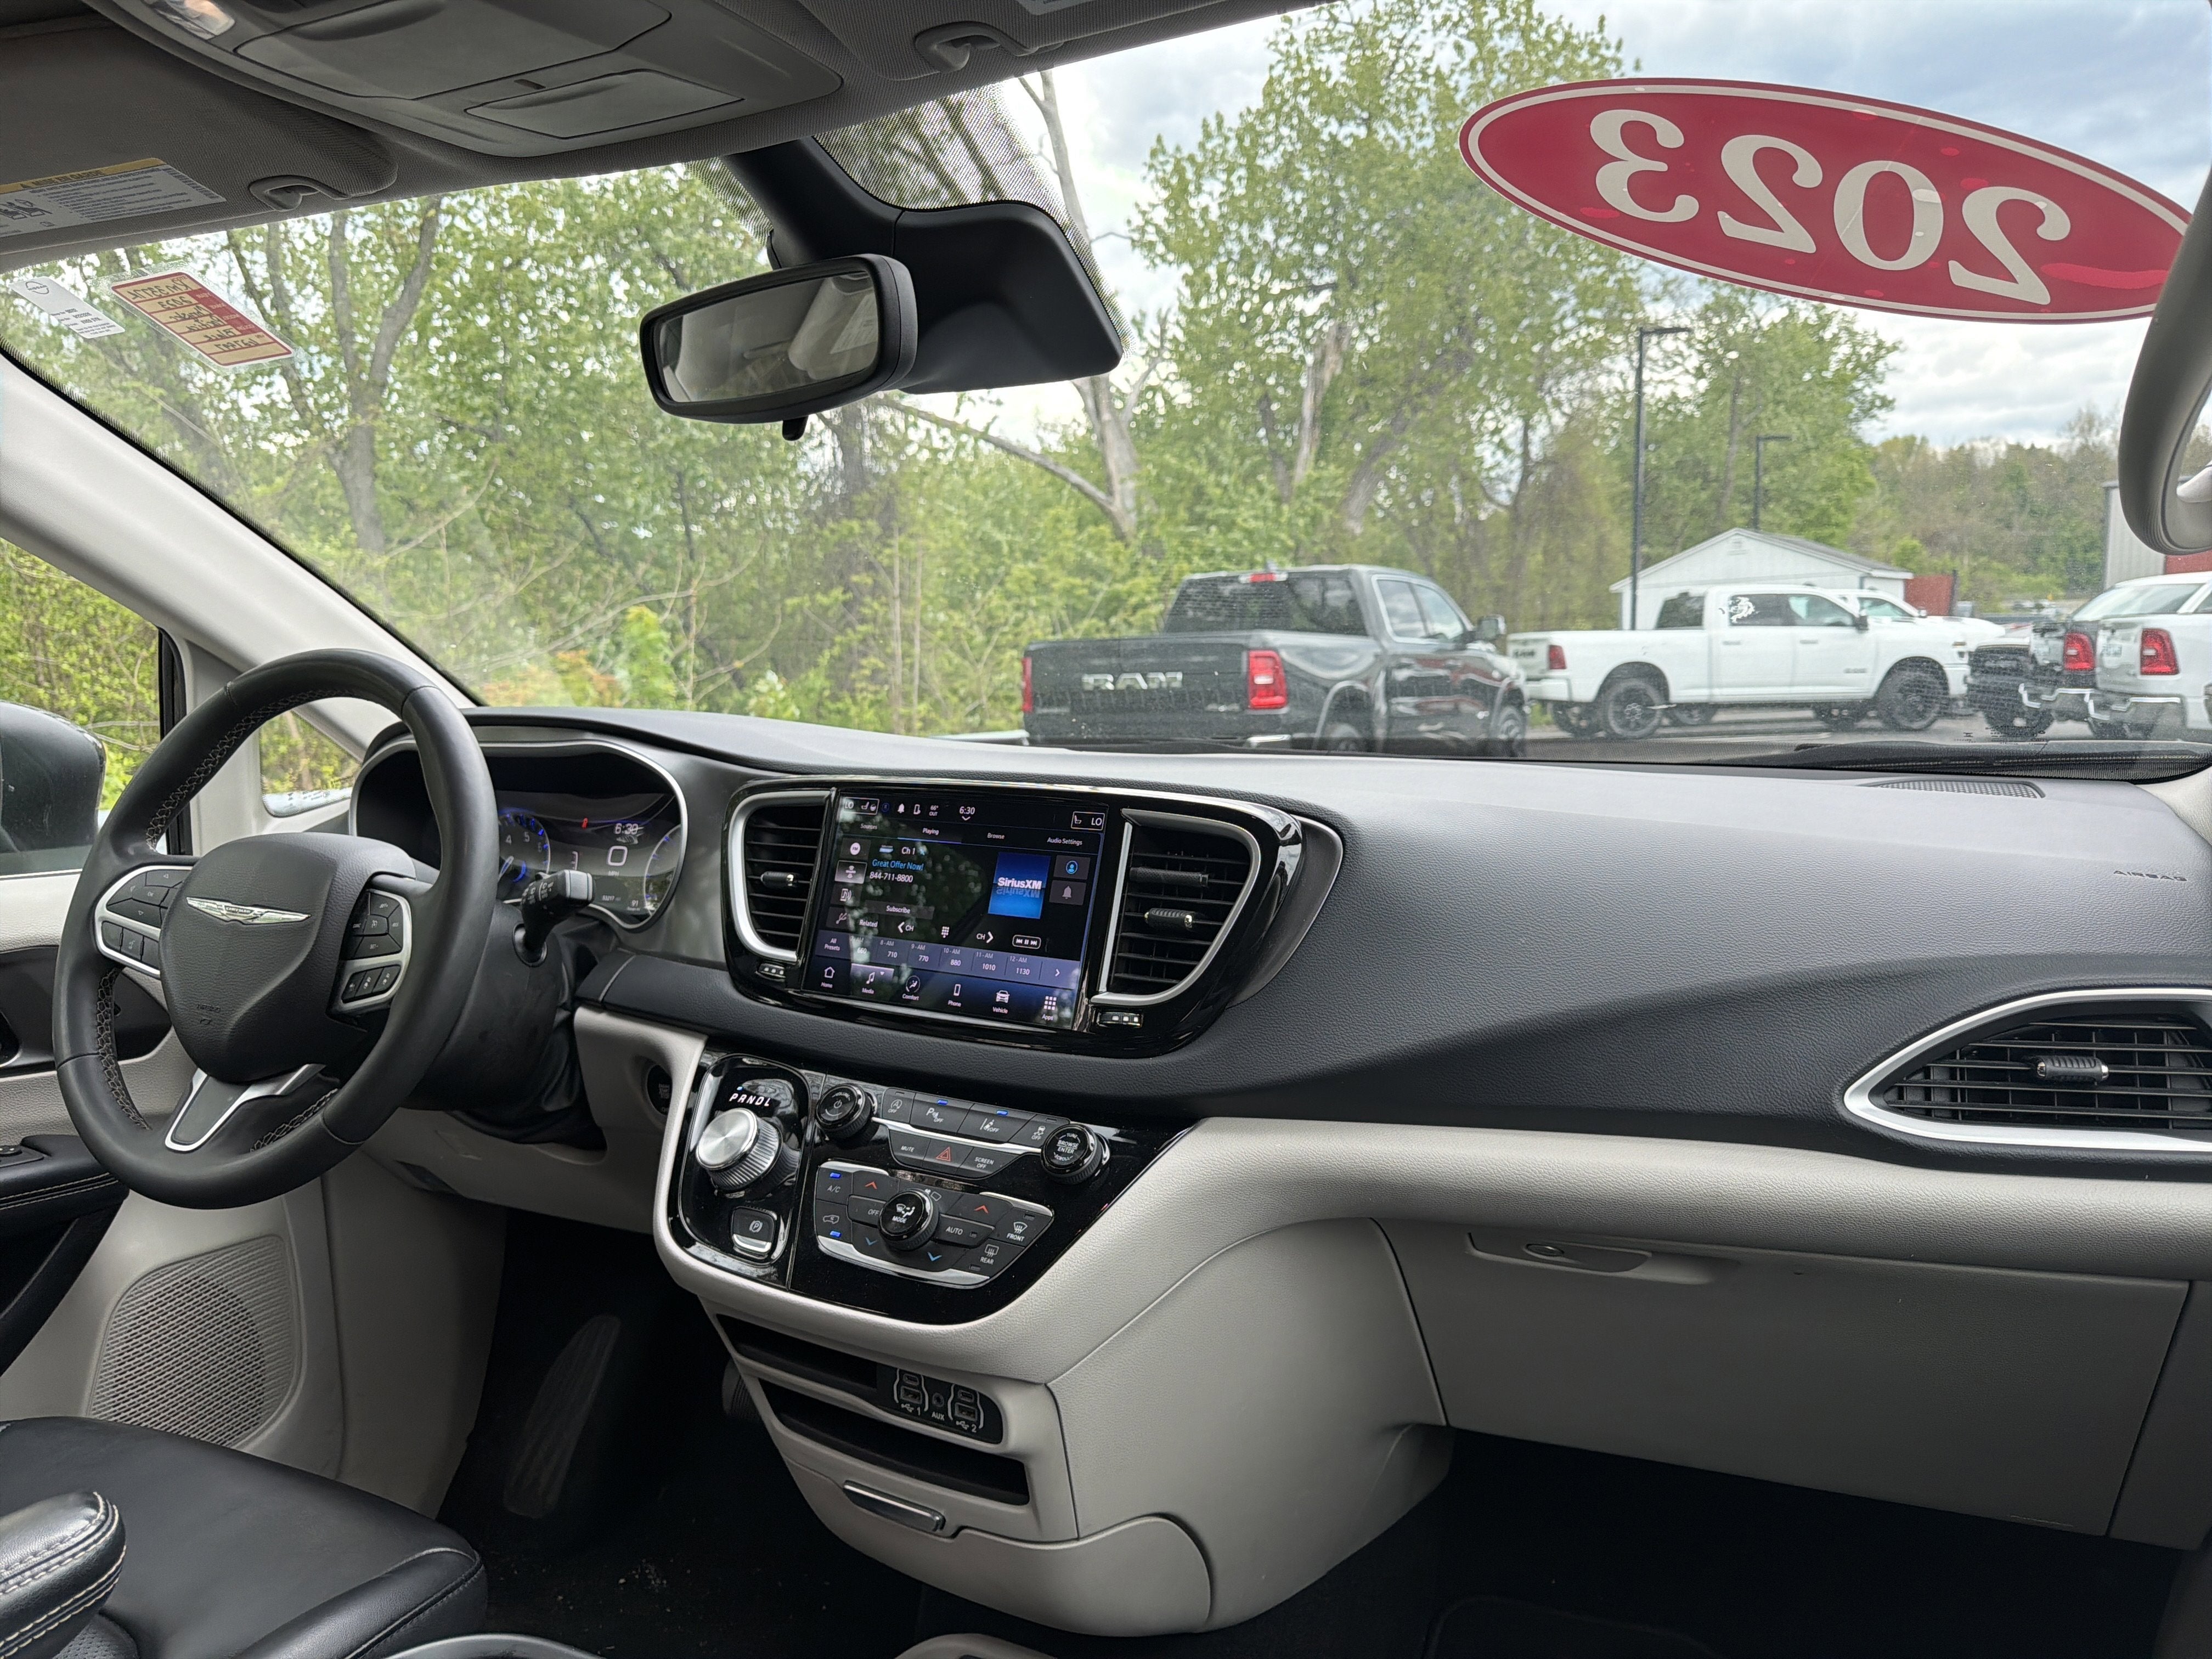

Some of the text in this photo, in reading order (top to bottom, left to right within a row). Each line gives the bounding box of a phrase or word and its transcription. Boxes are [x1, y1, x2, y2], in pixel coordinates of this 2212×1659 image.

[1081, 672, 1183, 691] RAM
[844, 801, 854, 809] LO
[960, 806, 975, 815] 6:30
[1091, 817, 1102, 826] LO
[923, 827, 939, 836] Playing
[506, 834, 512, 844] 4
[524, 832, 530, 842] 5
[607, 845, 628, 866] 0
[901, 847, 911, 855] Ch
[872, 859, 925, 871] Great Offer Now!
[870, 871, 913, 883] 844-711-8800
[2113, 870, 2188, 882] AIRBAG
[997, 877, 1042, 890] SiriusXM
[886, 905, 911, 914] Subscribe
[859, 919, 878, 928] Related
[982, 963, 996, 971] 1010
[1015, 967, 1030, 975] 1130
[992, 1006, 1008, 1014] Vehicle
[1058, 1139, 1079, 1148] BROWSE
[974, 1156, 995, 1165] SCREEN
[827, 1185, 841, 1193] A/C
[892, 1216, 907, 1224] MODE
[946, 1226, 963, 1235] AUTO
[1006, 1233, 1025, 1242] FRONT
[980, 1256, 994, 1265] REAR
[917, 1407, 921, 1415] 1
[932, 1412, 945, 1421] AUX
[972, 1424, 977, 1433] 2
